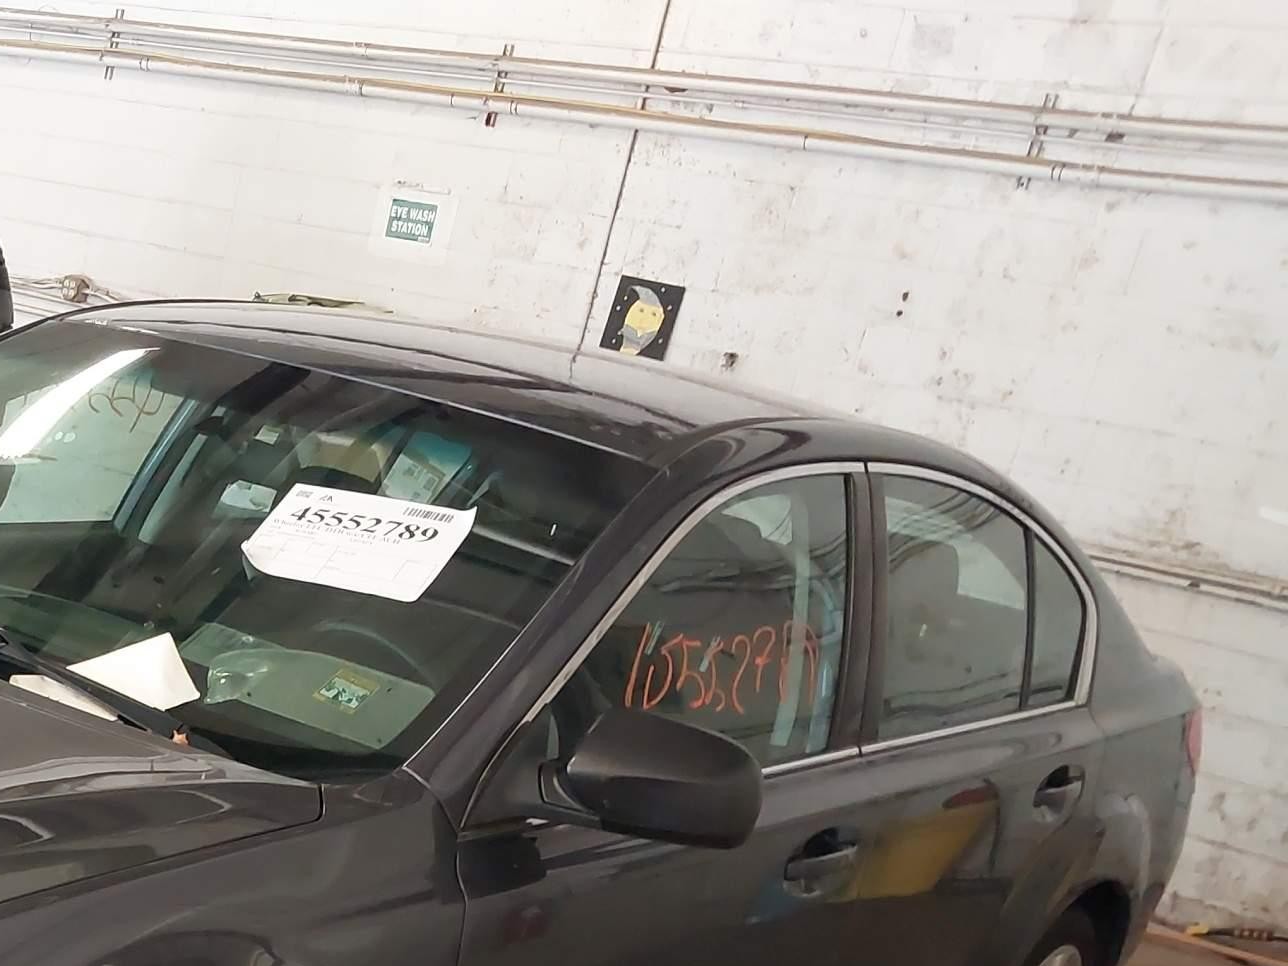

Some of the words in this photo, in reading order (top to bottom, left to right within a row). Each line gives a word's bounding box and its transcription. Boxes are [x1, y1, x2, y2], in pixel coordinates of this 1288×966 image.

[391, 205, 409, 219] EYE
[410, 207, 436, 223] WASH
[391, 220, 429, 237] STATION
[290, 506, 439, 543] 45552789
